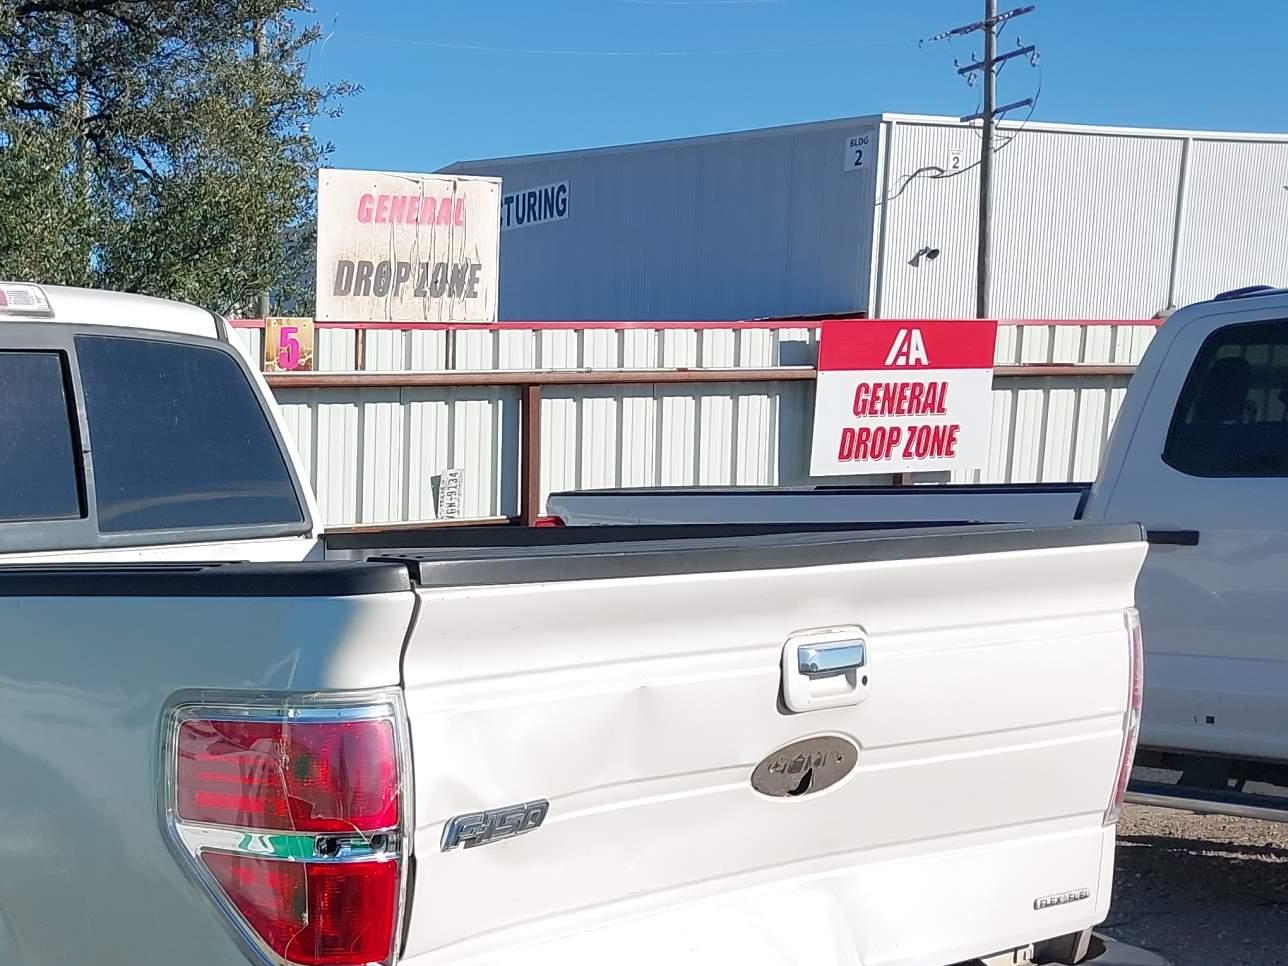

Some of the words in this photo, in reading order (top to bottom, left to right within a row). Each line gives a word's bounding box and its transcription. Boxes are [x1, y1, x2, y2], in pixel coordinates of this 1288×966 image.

[850, 136, 869, 147] BLDG
[854, 150, 863, 166] 2
[952, 157, 960, 169] 2
[357, 193, 465, 226] GENERAL
[501, 184, 567, 227] TURING
[333, 260, 411, 297] DROP
[414, 262, 482, 299] ZONE
[278, 327, 300, 369] 5
[852, 381, 949, 418] GENERAL
[838, 426, 902, 462] DROP
[902, 424, 960, 459] ZONE
